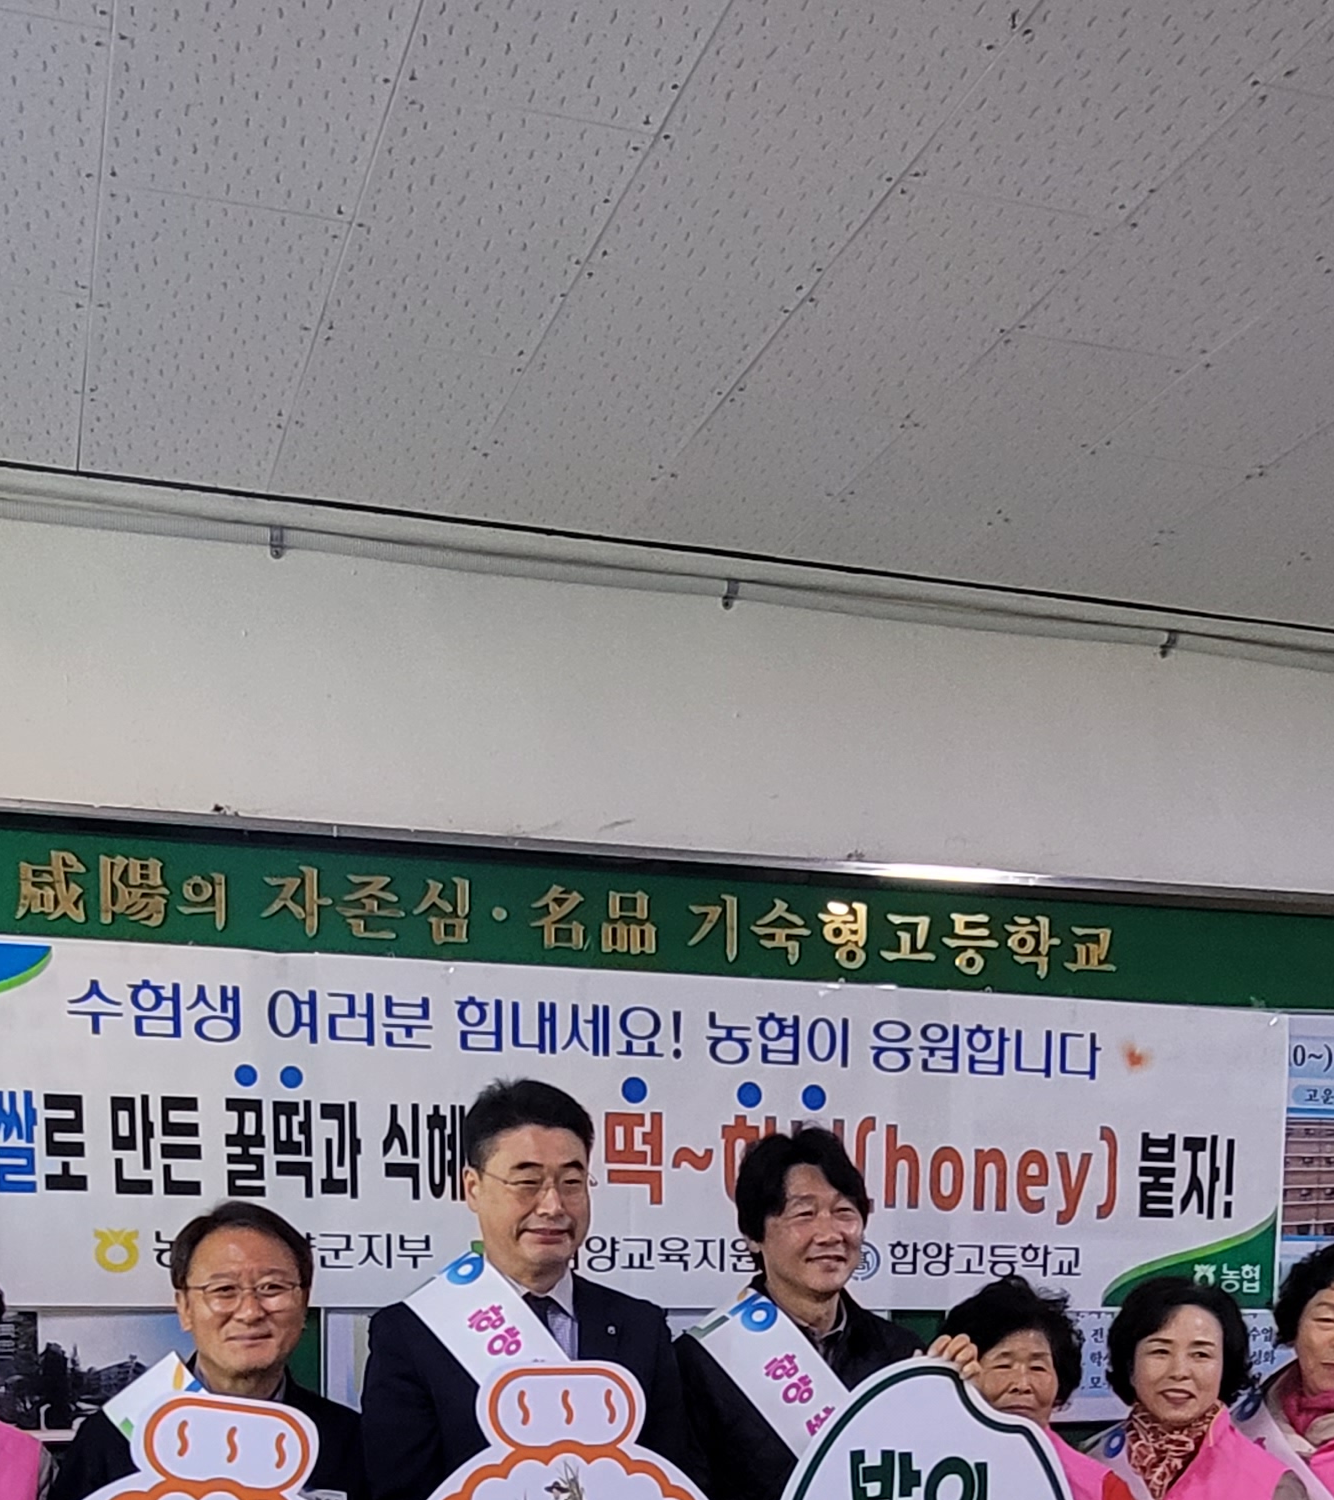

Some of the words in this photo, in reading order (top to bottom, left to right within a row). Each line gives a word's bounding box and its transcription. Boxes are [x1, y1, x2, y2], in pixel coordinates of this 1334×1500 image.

[16, 850, 227, 929] 咸陽의
[688, 894, 1116, 979] 기숙형고등학교
[67, 978, 241, 1044] 수험생
[267, 988, 434, 1049] 여러분
[454, 995, 684, 1060] 힘내세요!
[706, 1010, 851, 1068] 농협이
[868, 1018, 1103, 1081] 응원합니다
[110, 1095, 203, 1197] 만든
[224, 1098, 362, 1200] 꿀떡과
[381, 1103, 466, 1202] 식혜
[1138, 1130, 1236, 1221] 붙자!
[308, 1232, 434, 1270] 군지부
[569, 1236, 759, 1273] 양교육지원
[888, 1239, 1083, 1278] 함양고등학교
[1220, 1263, 1261, 1294] 농협
[467, 1303, 523, 1357] 함양
[764, 1353, 814, 1404] 함양
